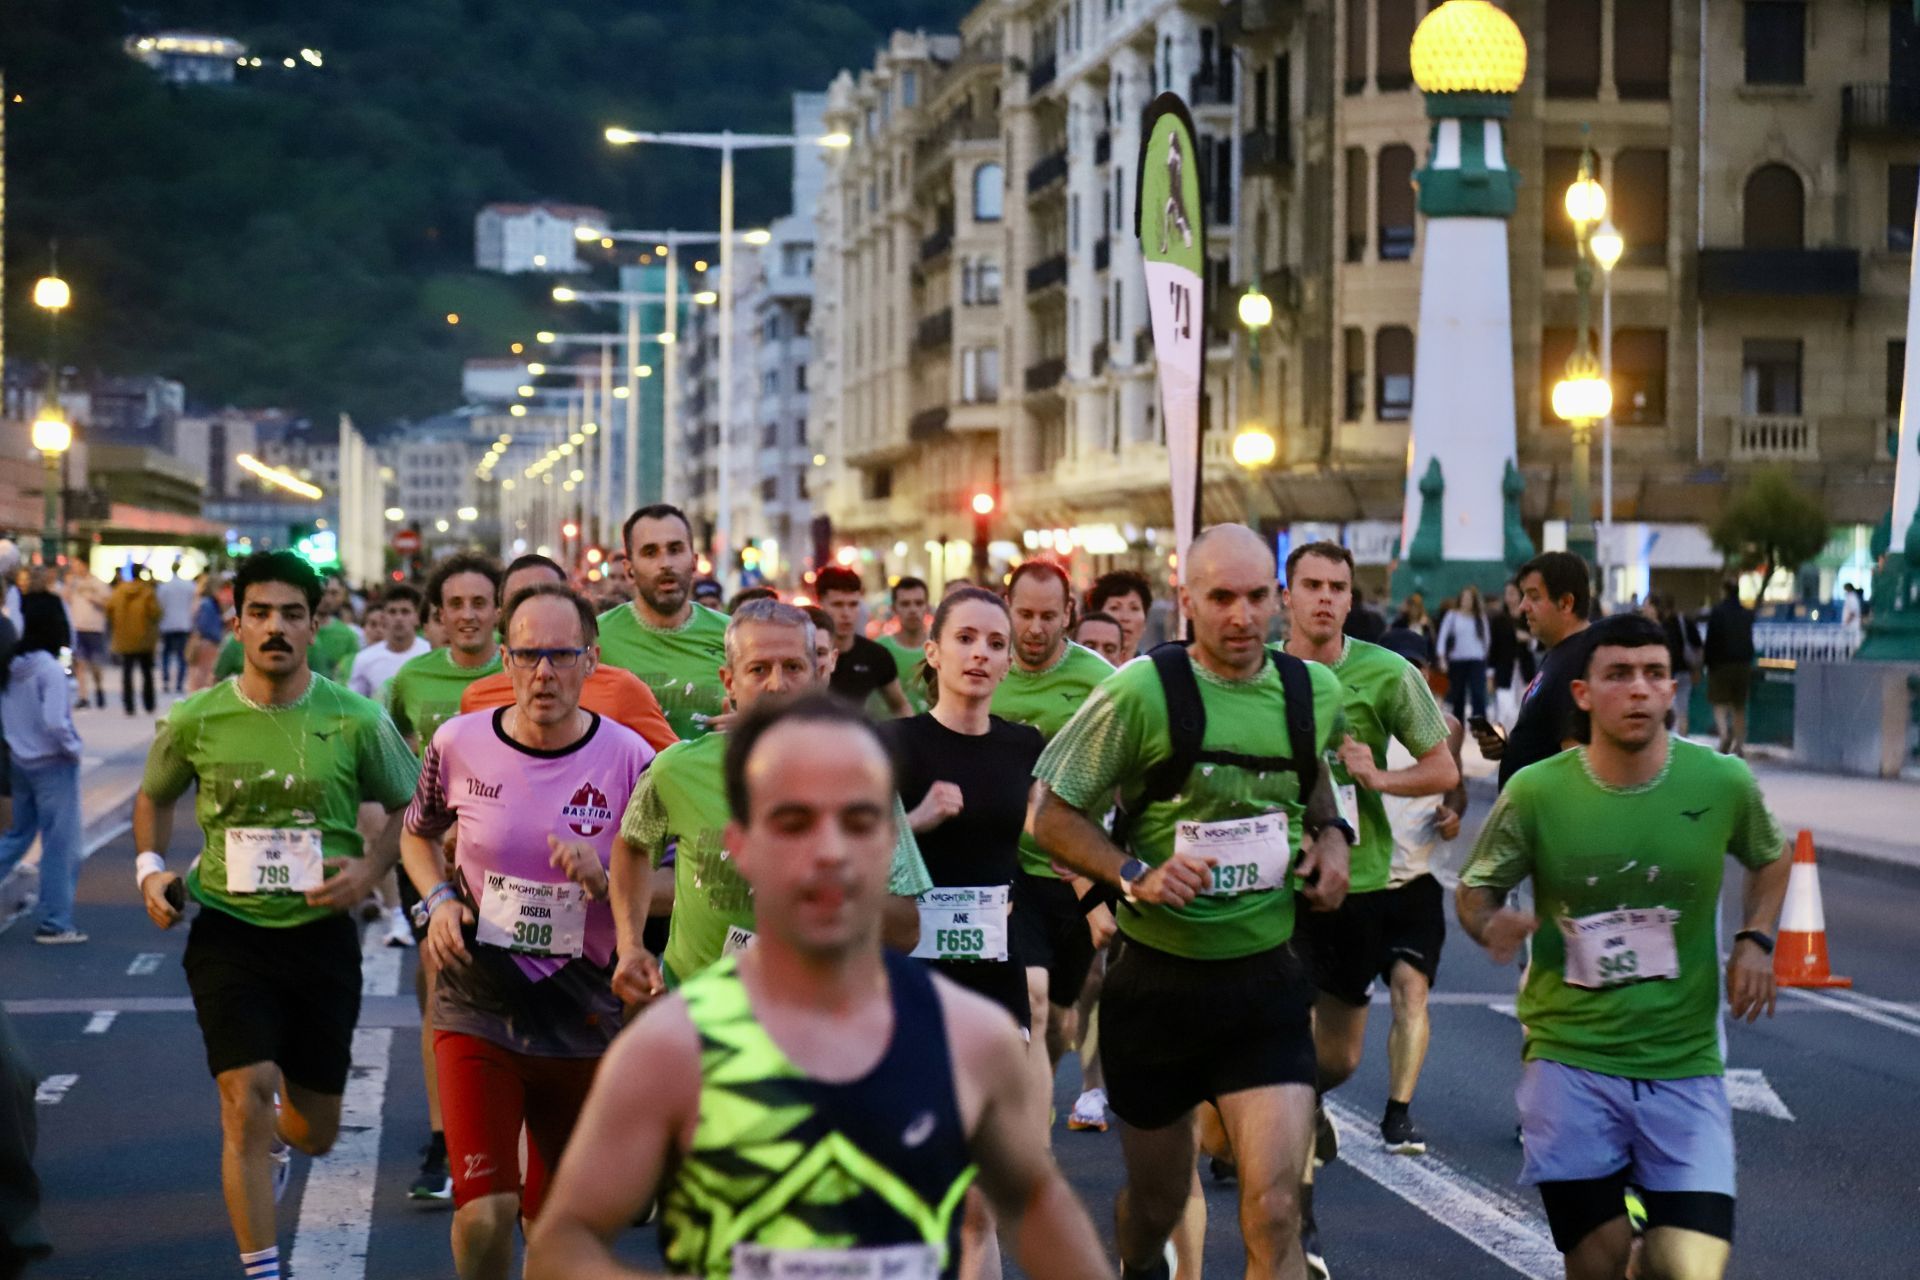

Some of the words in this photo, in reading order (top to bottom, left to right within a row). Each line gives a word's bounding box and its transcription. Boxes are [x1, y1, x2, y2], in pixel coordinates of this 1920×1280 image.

[466, 778, 503, 799] Vital
[562, 806, 612, 820] BASTIDA
[257, 865, 289, 884] 798
[487, 875, 506, 889] 10K
[1211, 862, 1259, 889] 1378
[519, 904, 552, 919] JOSEBA
[952, 912, 969, 924] ANE
[512, 921, 553, 946] 308
[730, 930, 752, 949] 10K
[936, 928, 984, 951] F653
